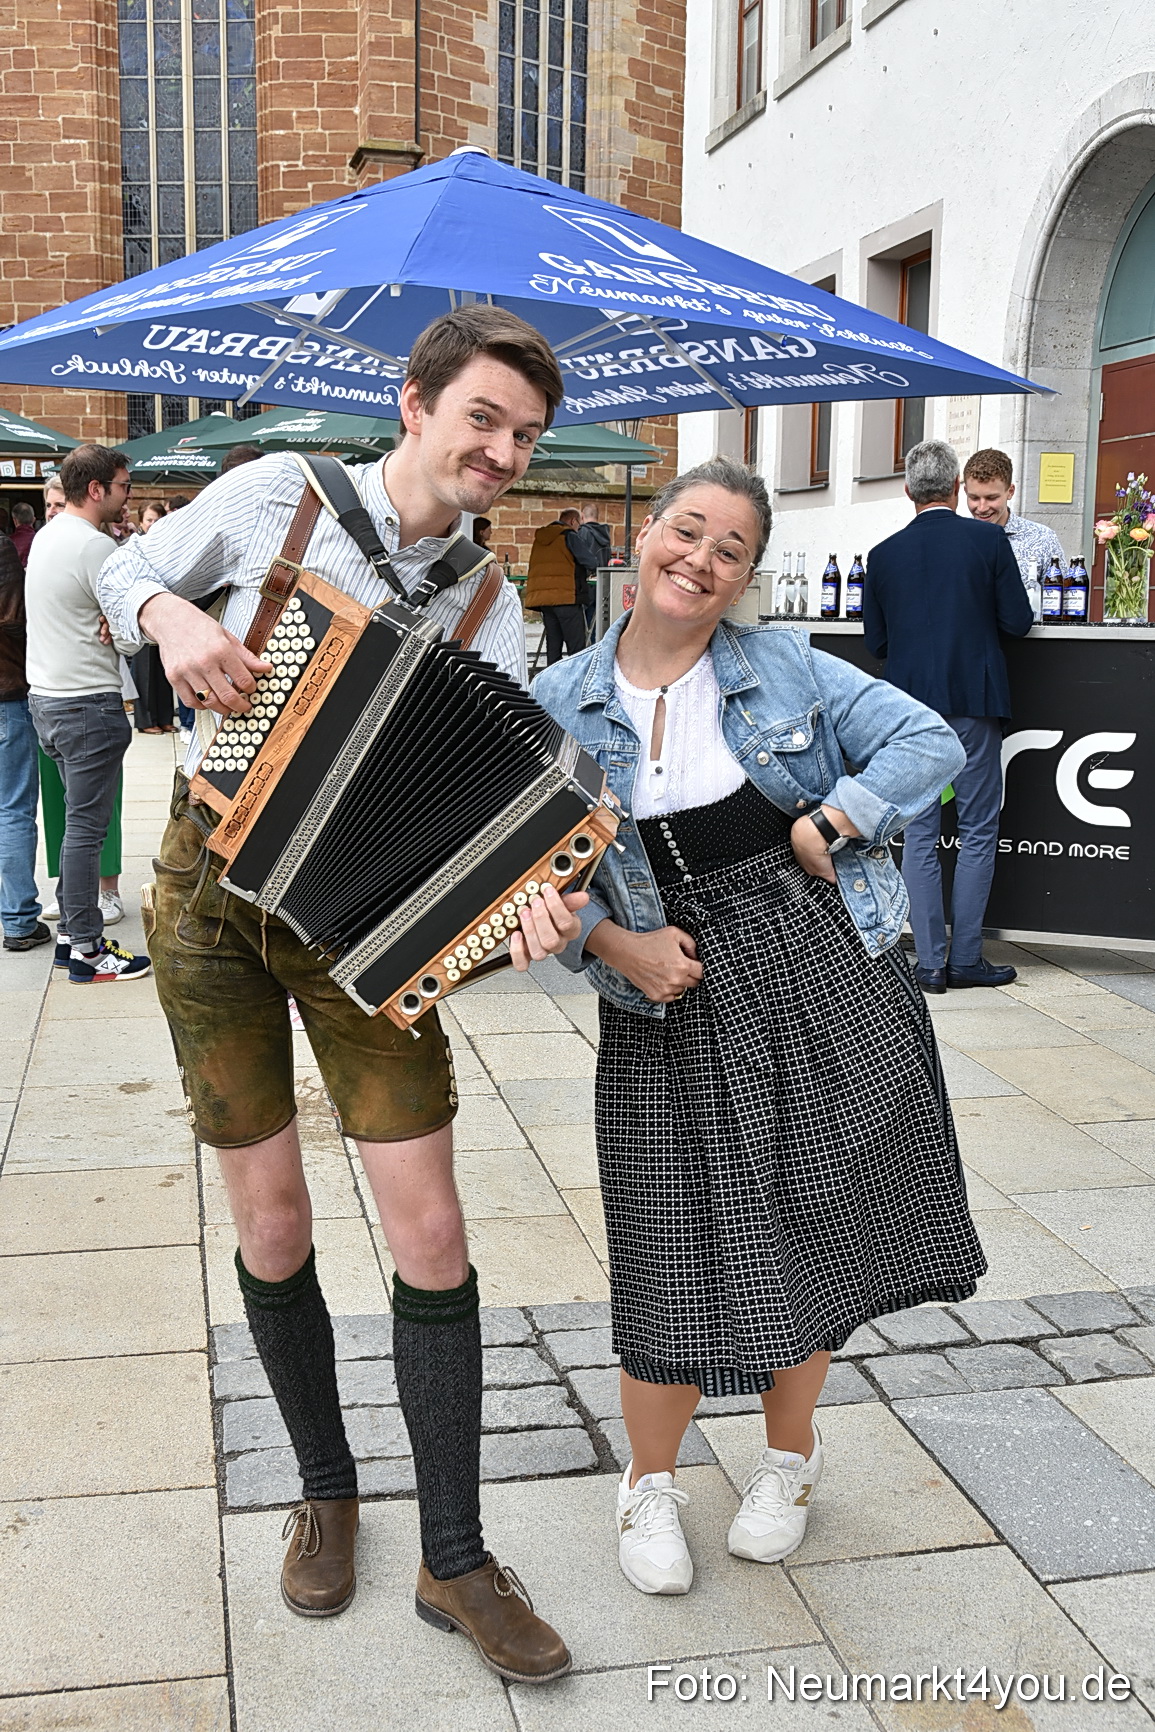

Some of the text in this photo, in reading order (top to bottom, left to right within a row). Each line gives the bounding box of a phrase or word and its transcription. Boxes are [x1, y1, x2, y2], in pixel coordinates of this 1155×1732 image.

[529, 273, 934, 360] Neumarkt's guter Schluck
[538, 252, 836, 322] GANSBRÄU
[1018, 840, 1063, 857] AND
[1069, 843, 1130, 860] MORE
